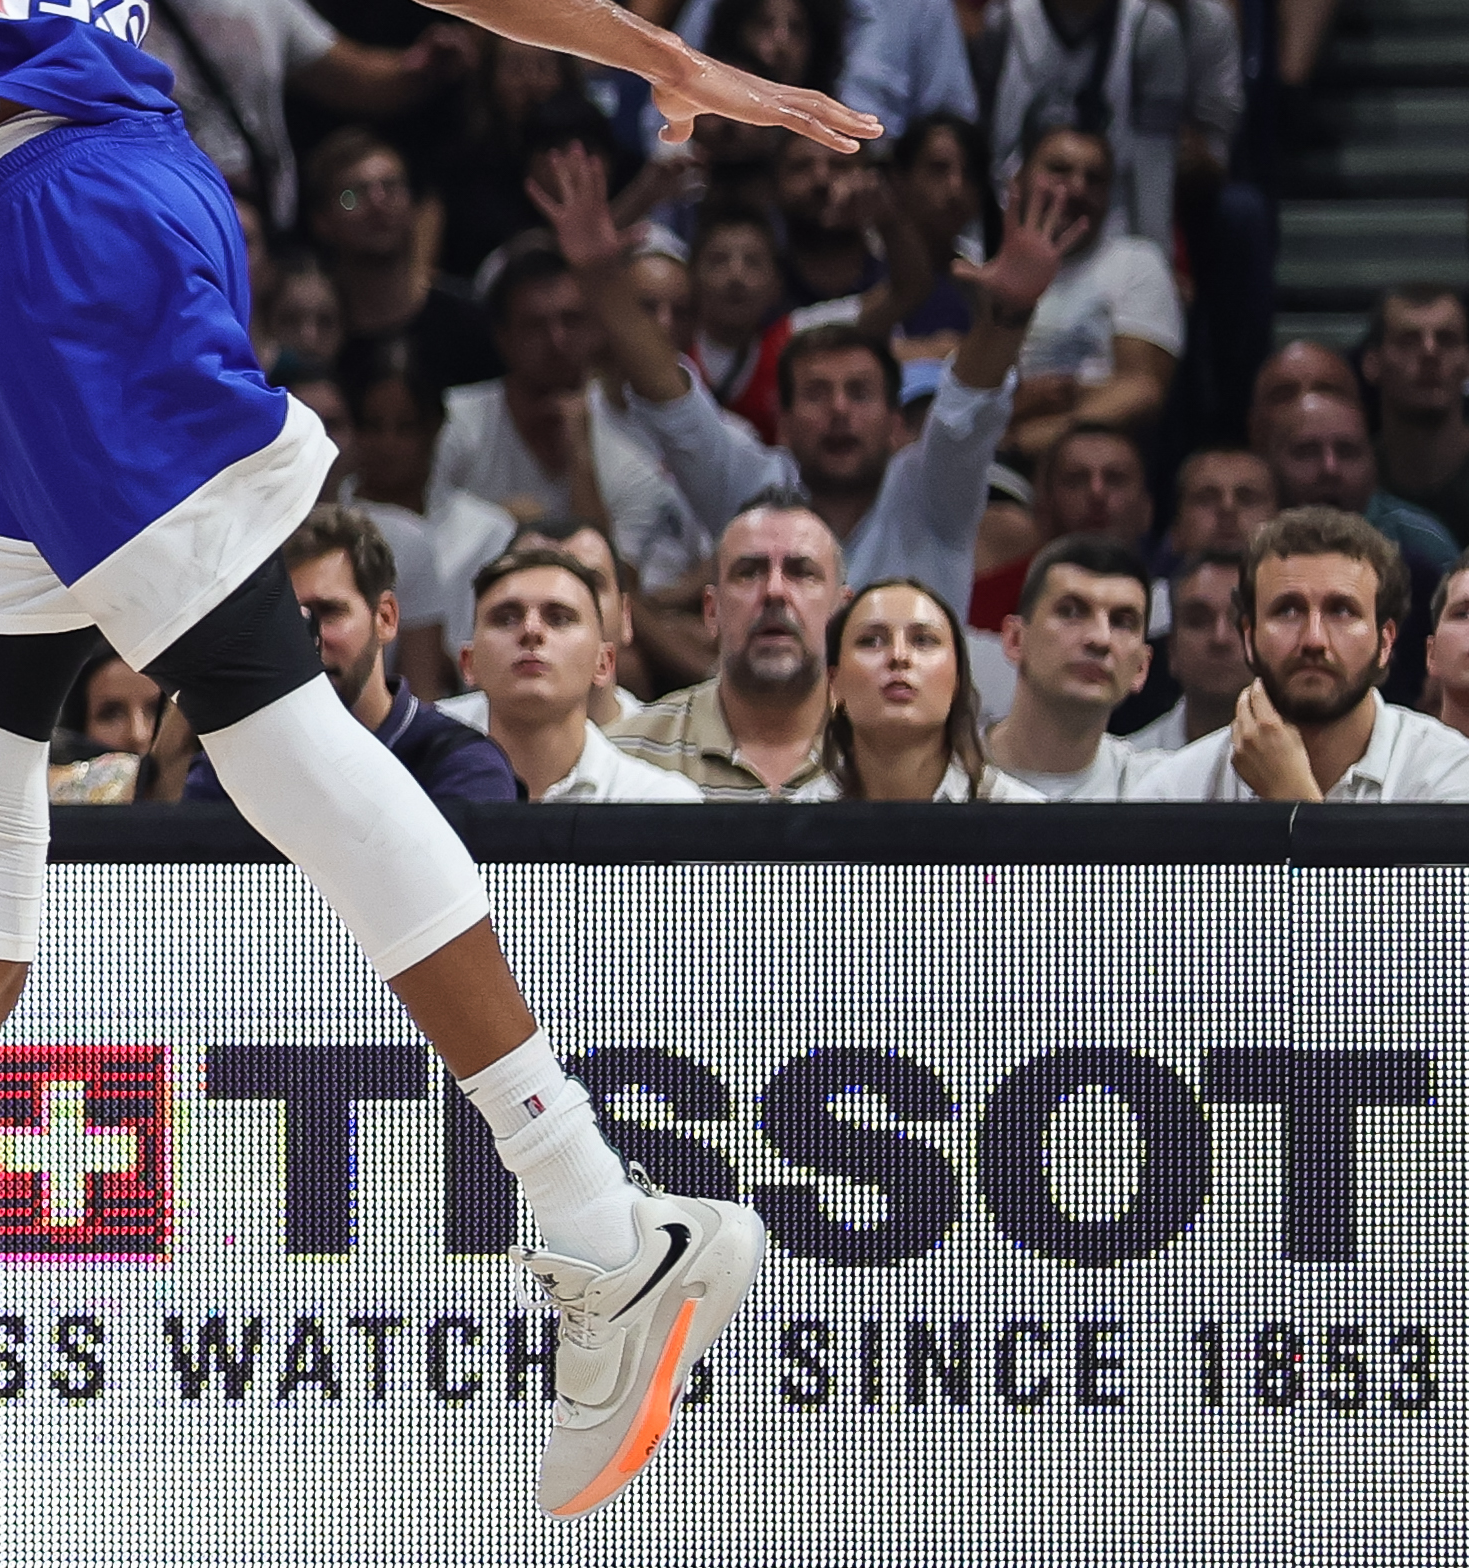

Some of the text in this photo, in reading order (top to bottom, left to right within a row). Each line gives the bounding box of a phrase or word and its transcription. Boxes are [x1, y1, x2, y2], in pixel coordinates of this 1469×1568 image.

[165, 1314, 712, 1405] WATCH
[779, 1318, 1127, 1412] SINCE
[1188, 1319, 1440, 1414] 1853
